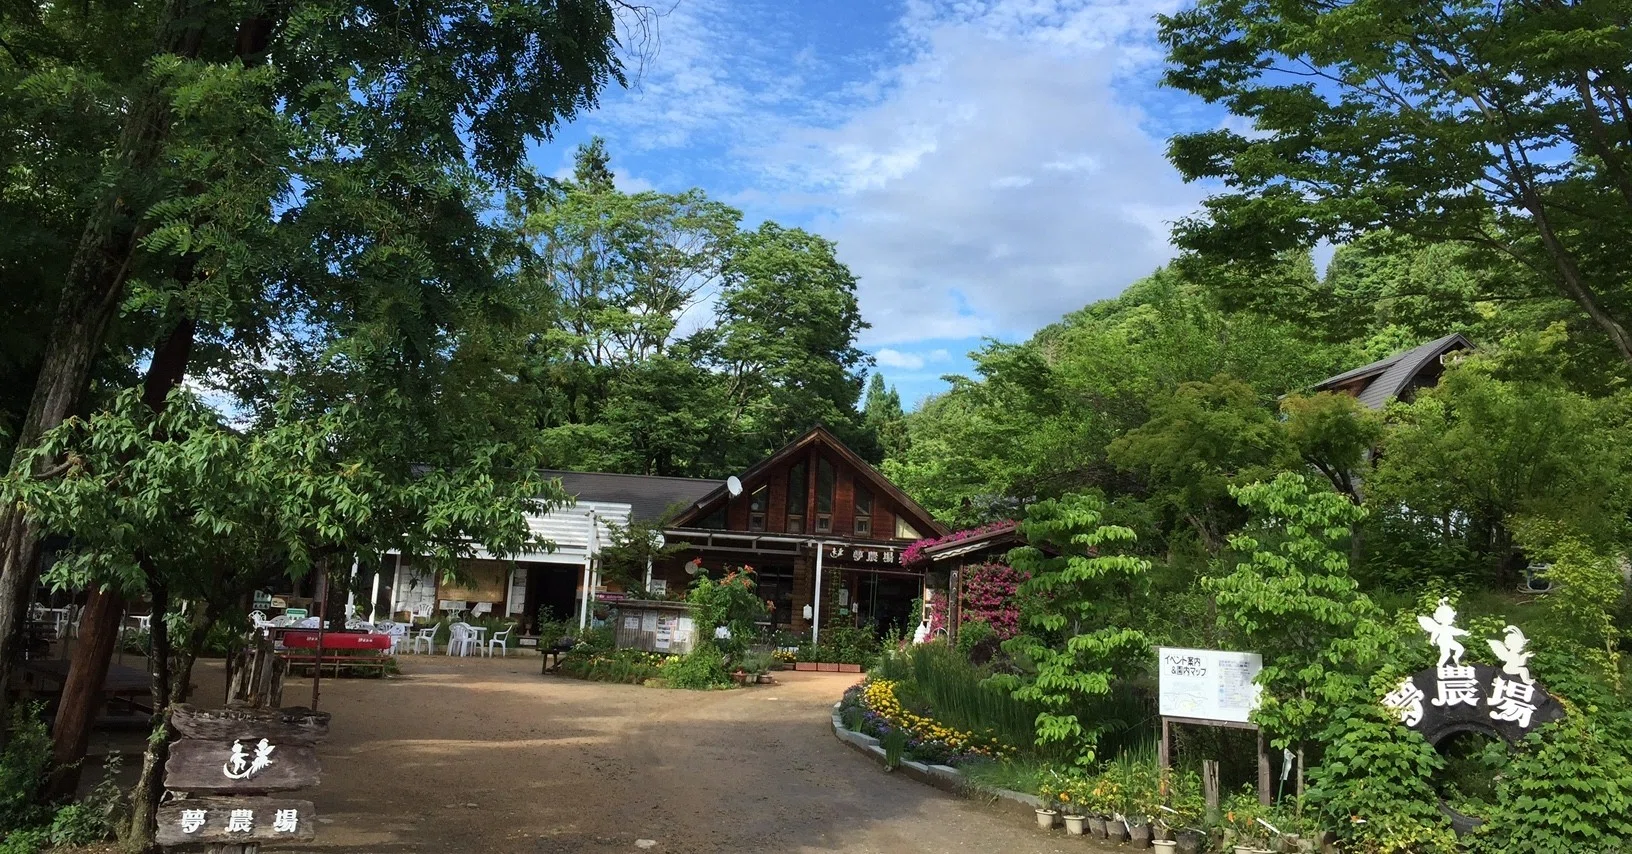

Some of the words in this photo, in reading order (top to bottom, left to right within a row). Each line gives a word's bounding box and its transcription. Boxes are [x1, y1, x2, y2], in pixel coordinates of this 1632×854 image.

[853, 550, 903, 564] 夢農場
[1164, 655, 1201, 667] イベント案内
[1380, 665, 1537, 728] 夢農場
[181, 809, 299, 833] 夢農場
